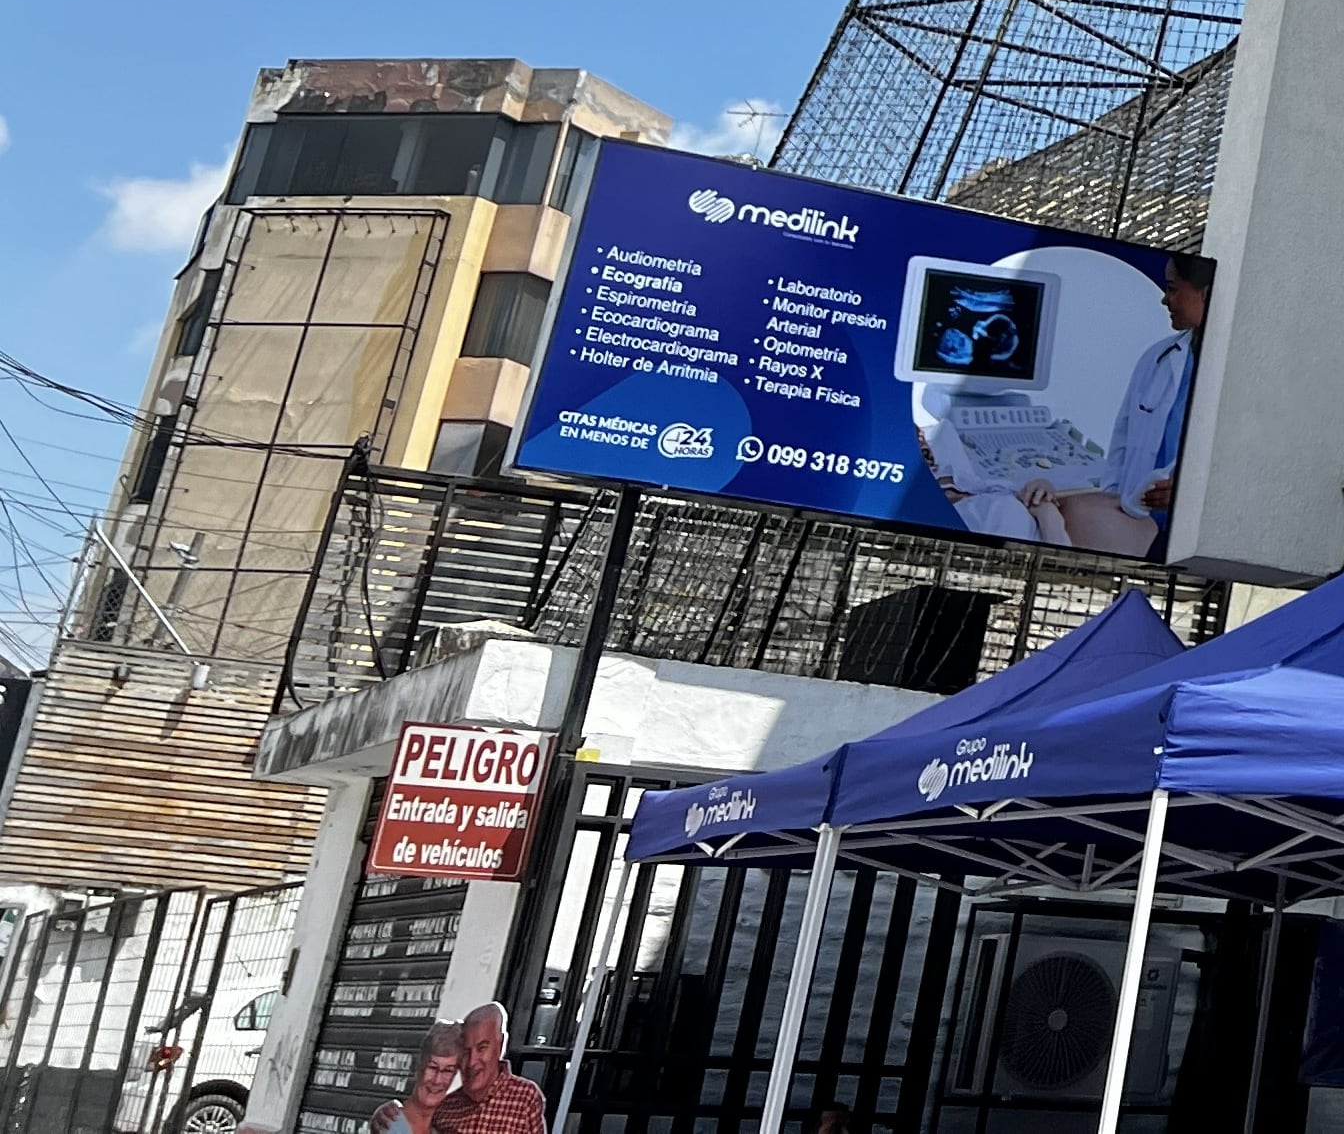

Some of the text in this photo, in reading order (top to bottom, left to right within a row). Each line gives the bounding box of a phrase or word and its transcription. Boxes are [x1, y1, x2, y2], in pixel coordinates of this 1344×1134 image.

[737, 203, 860, 243] medilink
[606, 245, 703, 277] Audiometría
[601, 265, 684, 294] Ecografía
[776, 276, 862, 306] Laboratorio
[596, 285, 698, 317] Espirometría
[772, 296, 887, 331] Monitor presión
[591, 305, 720, 342] Ecocardiograma
[766, 316, 822, 339] Arterial
[585, 326, 739, 366] Electrocardiograma
[763, 336, 848, 365] Optometría
[580, 346, 719, 384] Holter de Arritmia
[758, 355, 825, 380] Rayos X
[755, 375, 861, 408] Terapia Física
[559, 410, 658, 437] CITAS MÉDICAS
[559, 425, 650, 450] EN MENOS DE
[679, 429, 711, 447] 24
[673, 446, 712, 457] HORAS
[767, 444, 905, 484] 099 318 3975
[399, 733, 541, 787] PELIGRO
[948, 741, 1034, 787] medilink
[386, 793, 529, 833] Entrada y salida
[392, 835, 504, 870] de vehículos
